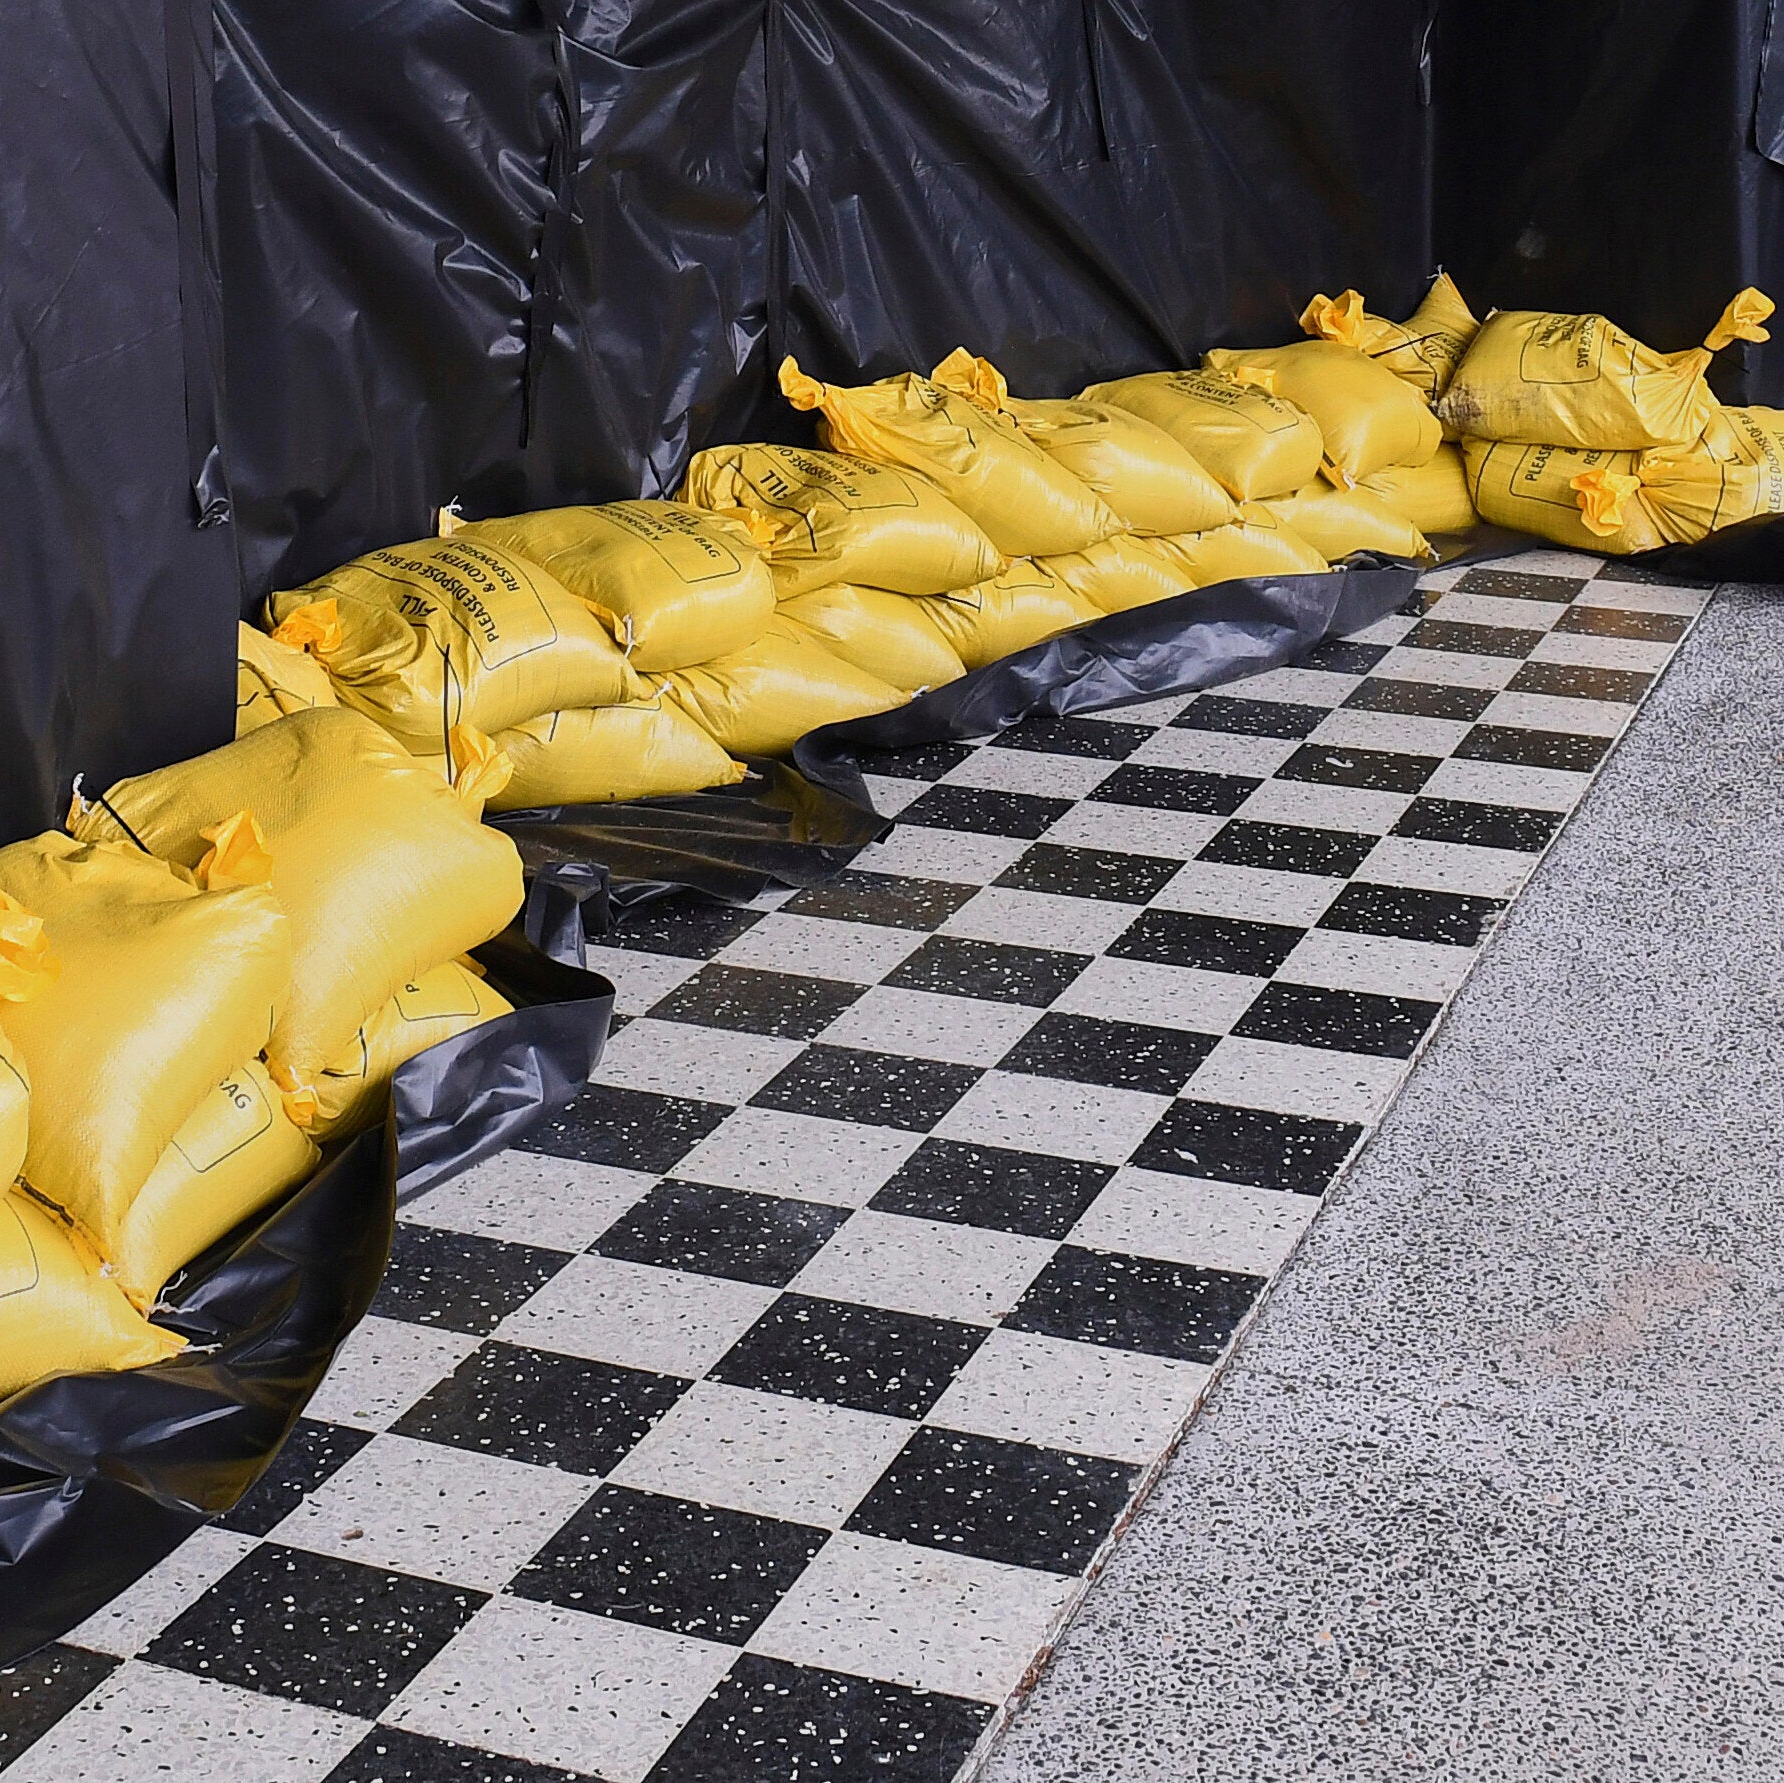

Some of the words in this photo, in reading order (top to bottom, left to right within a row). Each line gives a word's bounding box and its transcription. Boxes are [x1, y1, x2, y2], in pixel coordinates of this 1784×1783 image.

[1576, 348, 1590, 369] BAG
[1525, 445, 1555, 482] PLEASE
[1724, 452, 1744, 466] LL
[663, 511, 701, 527] FILL
[693, 537, 721, 558] BAG
[372, 551, 406, 567] BAG
[401, 559, 423, 571] OF
[429, 551, 488, 584] CONTENT
[445, 541, 521, 592] RESPONSIBLY
[418, 565, 468, 601] DISPOSE
[482, 581, 497, 594] &
[398, 593, 438, 617] FILL
[462, 594, 500, 644] PLEASE
